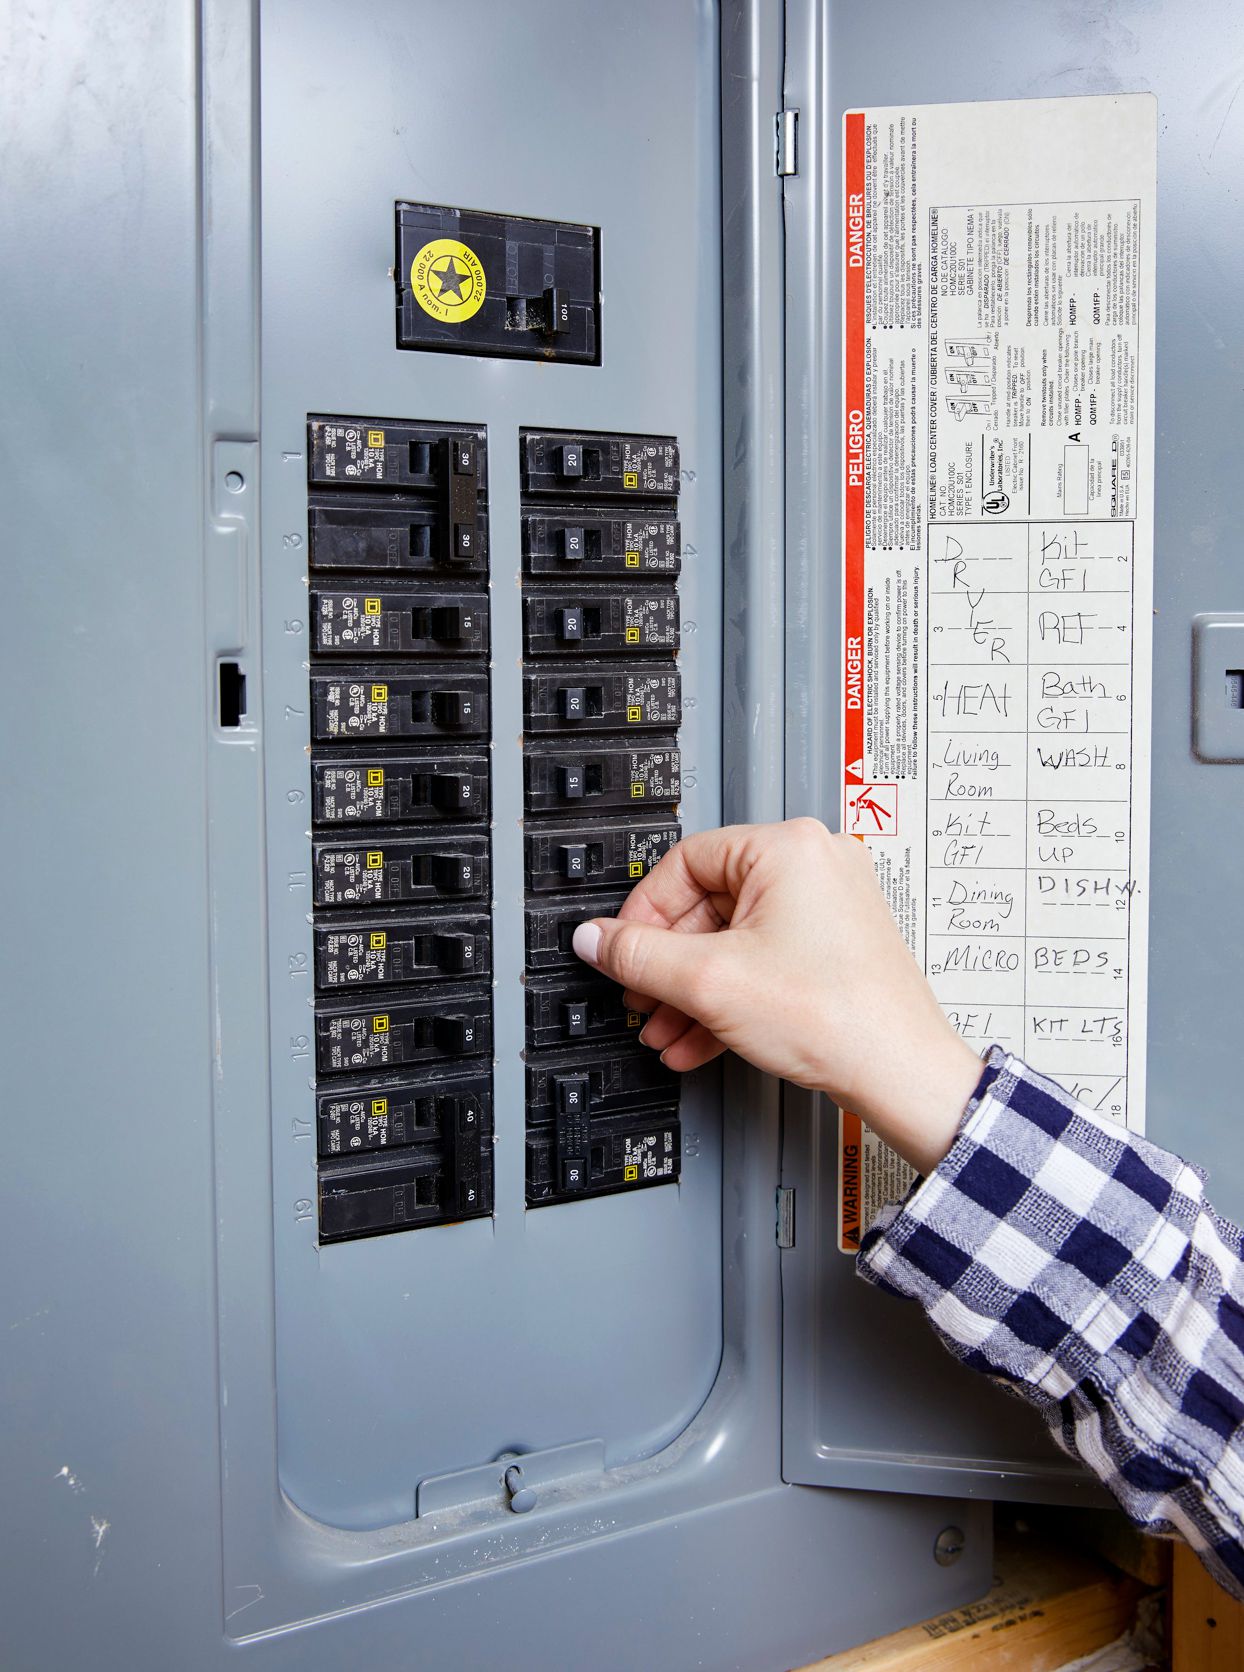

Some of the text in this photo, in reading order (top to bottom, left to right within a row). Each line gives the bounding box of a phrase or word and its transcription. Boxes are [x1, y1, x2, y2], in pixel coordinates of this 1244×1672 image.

[850, 193, 863, 267] DANGER
[423, 250, 434, 262] 22
[463, 251, 477, 267] AIR
[417, 263, 426, 280] 000
[942, 272, 949, 281] DE
[931, 284, 938, 298] DE
[422, 293, 442, 314] nom.
[1069, 432, 1081, 442] A
[849, 410, 863, 486] PELIGRO
[462, 453, 470, 465] 30
[569, 454, 577, 466] 20
[965, 442, 973, 489] ENCLOSURE
[682, 470, 696, 482] 2
[965, 496, 973, 516] TYPE
[866, 508, 872, 518] DE
[282, 533, 303, 549] 3
[463, 534, 470, 547] 30
[571, 538, 579, 550] 20
[682, 544, 697, 559] 4
[1040, 530, 1088, 565] Kit
[284, 620, 304, 635] 5
[464, 616, 471, 628] 15
[569, 618, 576, 630] 20
[682, 621, 697, 632] 6
[1038, 611, 1098, 645] REF
[867, 626, 874, 637] OR
[847, 636, 861, 709] DANGER
[1042, 672, 1106, 699] Bath
[571, 698, 579, 710] 20
[683, 697, 697, 709] 8
[943, 680, 1008, 717] HEAT
[285, 705, 303, 720] 7
[464, 702, 471, 714] 15
[372, 711, 378, 721] kA
[867, 717, 874, 726] OF
[944, 738, 999, 770] Living
[1037, 745, 1108, 770] WASH
[570, 777, 578, 789] 15
[683, 766, 697, 788] 10
[463, 786, 470, 798] 20
[945, 772, 993, 799] Room
[287, 790, 305, 803] 9
[944, 812, 991, 835] Kit
[1037, 810, 1098, 835] Beds
[1116, 831, 1125, 843] 10
[572, 858, 580, 870] 20
[463, 866, 471, 879] 20
[289, 872, 306, 891] 11
[933, 897, 942, 907] 11
[946, 880, 1014, 918] Dining
[1116, 899, 1125, 911] 12
[947, 909, 1000, 932] Room
[465, 946, 472, 958] 20
[1034, 947, 1109, 969] BEDS
[289, 952, 308, 979] 13
[932, 964, 942, 976] 13
[1114, 969, 1123, 980] 14
[572, 1015, 580, 1026] 15
[1033, 1017, 1123, 1038] KIT LTS
[465, 1029, 473, 1041] 20
[290, 1035, 310, 1062] 15
[1113, 1036, 1122, 1048] 16
[569, 1092, 578, 1103] 30
[467, 1110, 474, 1122] 40
[1111, 1105, 1121, 1116] 18
[292, 1118, 311, 1141] 17
[570, 1169, 579, 1181] 30
[844, 1145, 858, 1224] WARNING
[468, 1189, 475, 1201] 40
[294, 1199, 313, 1223] 19
